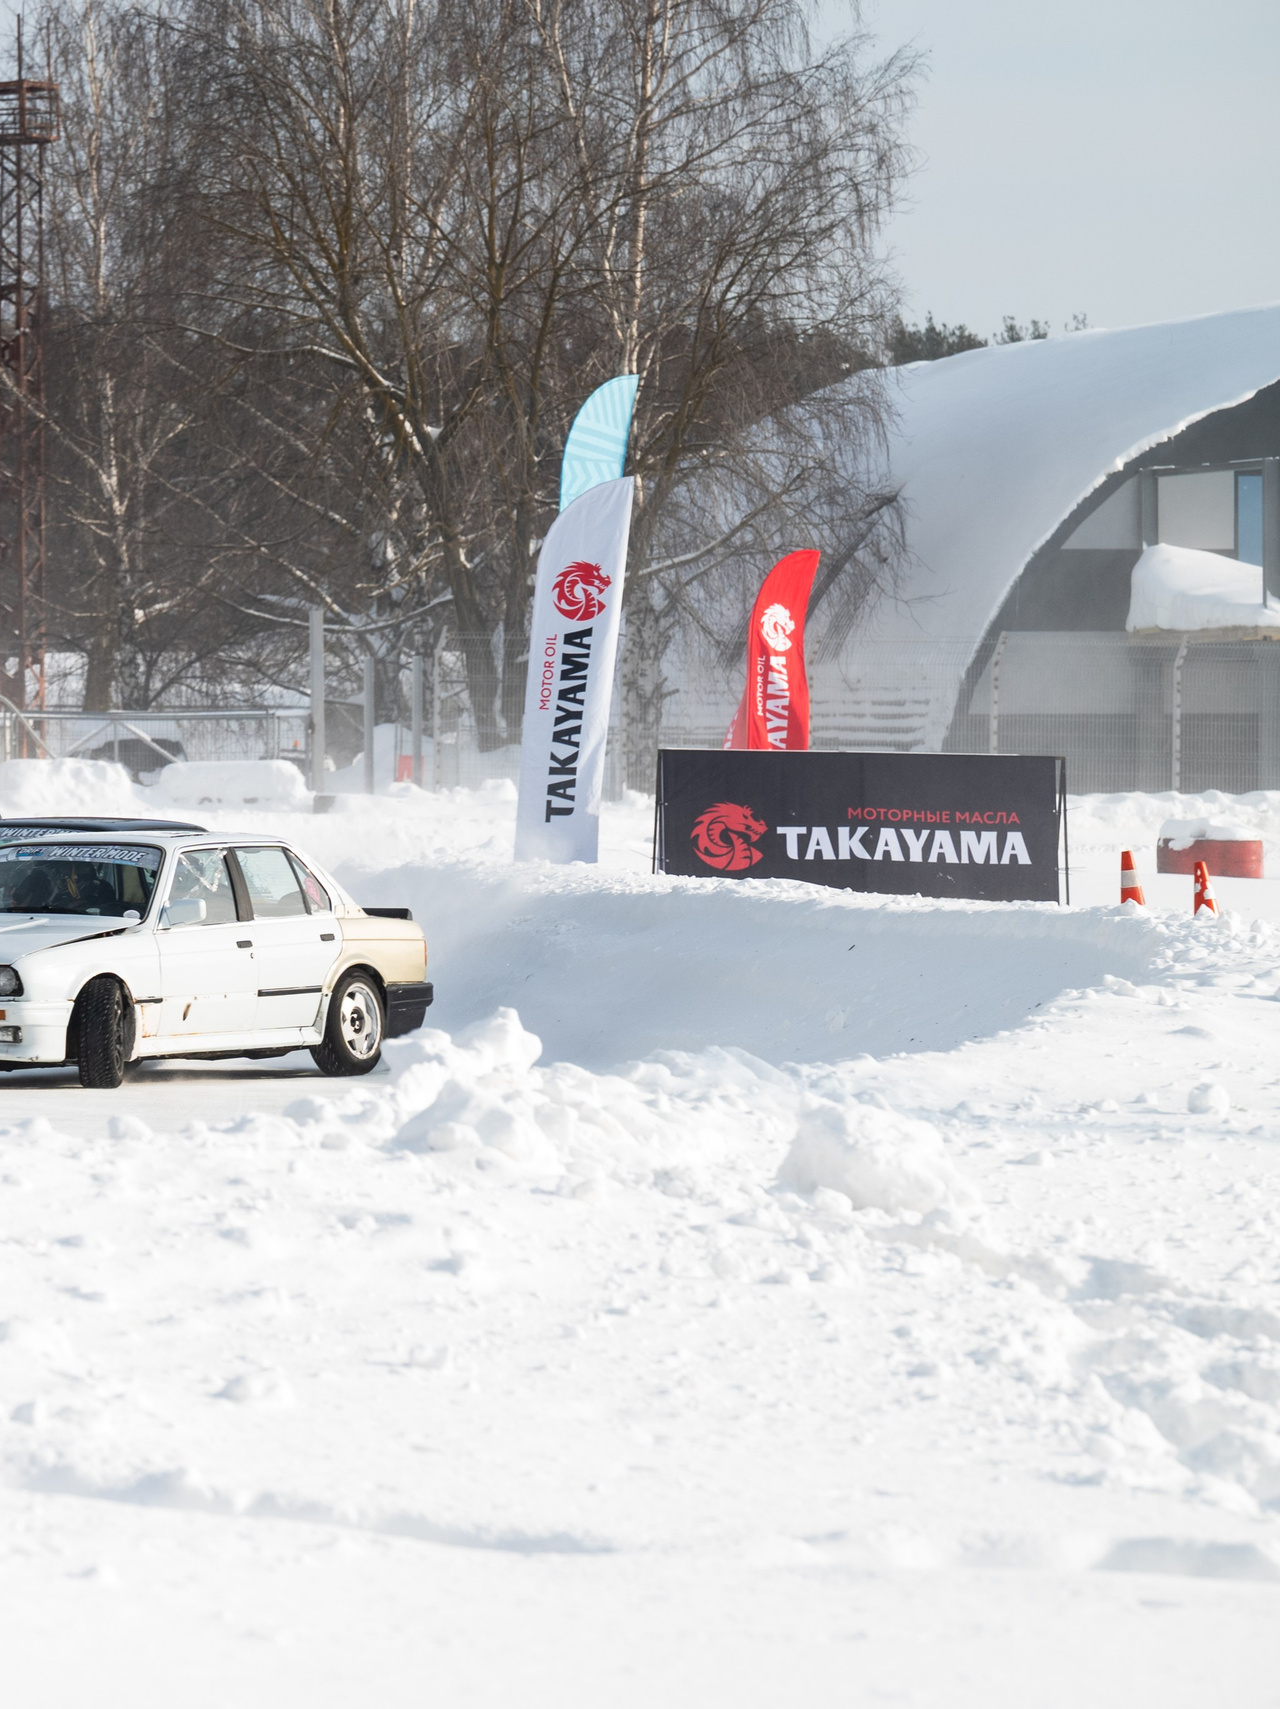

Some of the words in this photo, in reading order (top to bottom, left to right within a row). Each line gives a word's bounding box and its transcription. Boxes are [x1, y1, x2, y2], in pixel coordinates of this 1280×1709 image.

[544, 633, 557, 657] OIL
[757, 655, 766, 675] OIL
[539, 659, 556, 710] MOTOR
[756, 675, 765, 717] MOTOR
[765, 655, 790, 751] AYAMA
[545, 626, 593, 823] TAKAYAMA
[847, 806, 951, 823] МОТОРНЫЕ
[955, 810, 1020, 825] МАСЛА
[49, 846, 105, 858] WINTER
[104, 849, 148, 862] MODE
[776, 825, 1032, 865] TAKAYAMA
